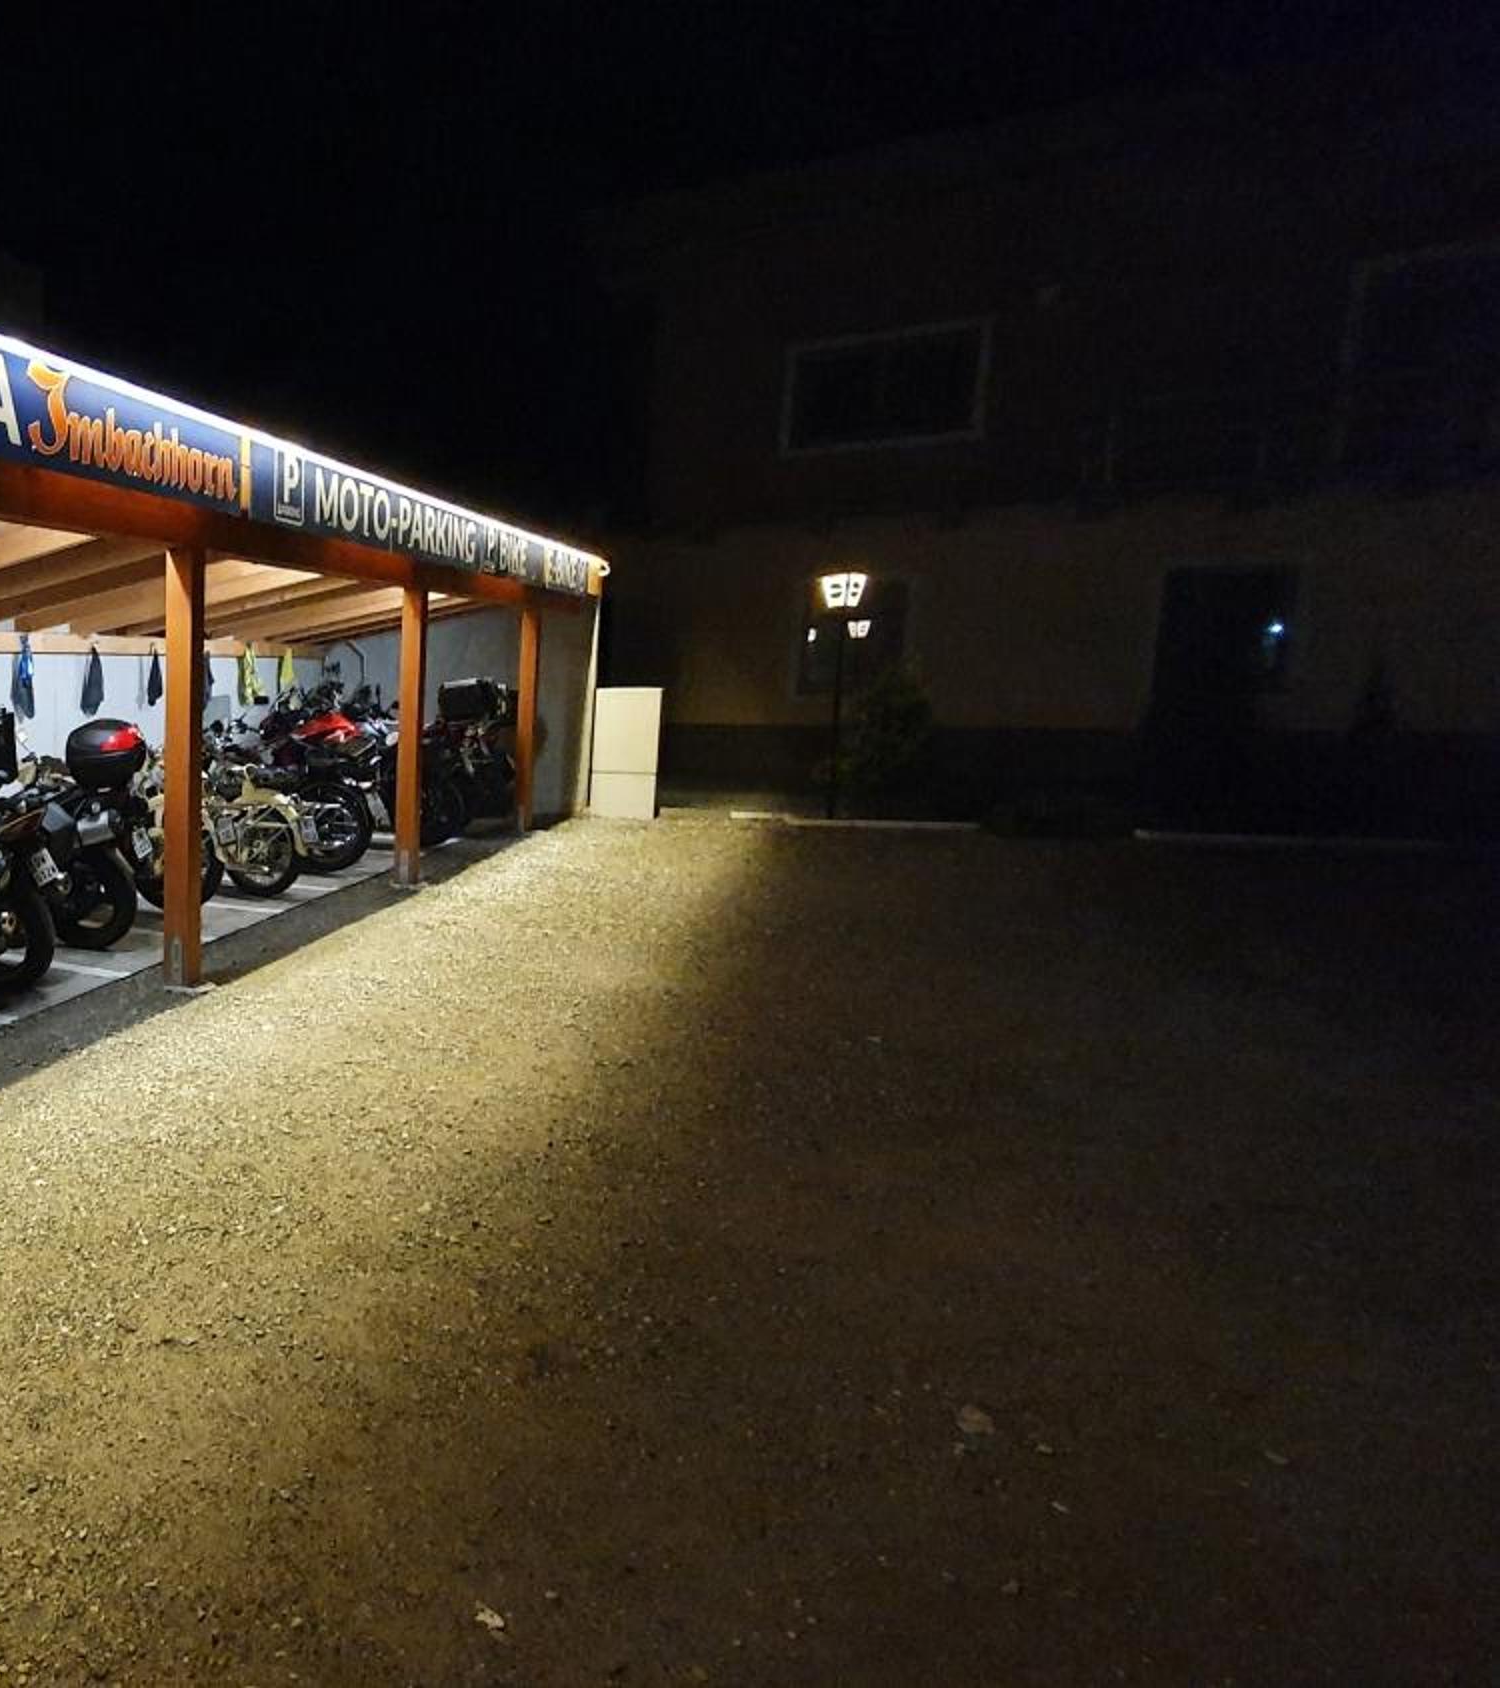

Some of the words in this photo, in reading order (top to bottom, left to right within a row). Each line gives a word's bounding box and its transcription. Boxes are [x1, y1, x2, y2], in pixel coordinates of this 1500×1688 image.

[27, 359, 236, 503] Imbachhorn
[283, 450, 300, 504] P
[313, 467, 478, 564] MOTO-PARKING
